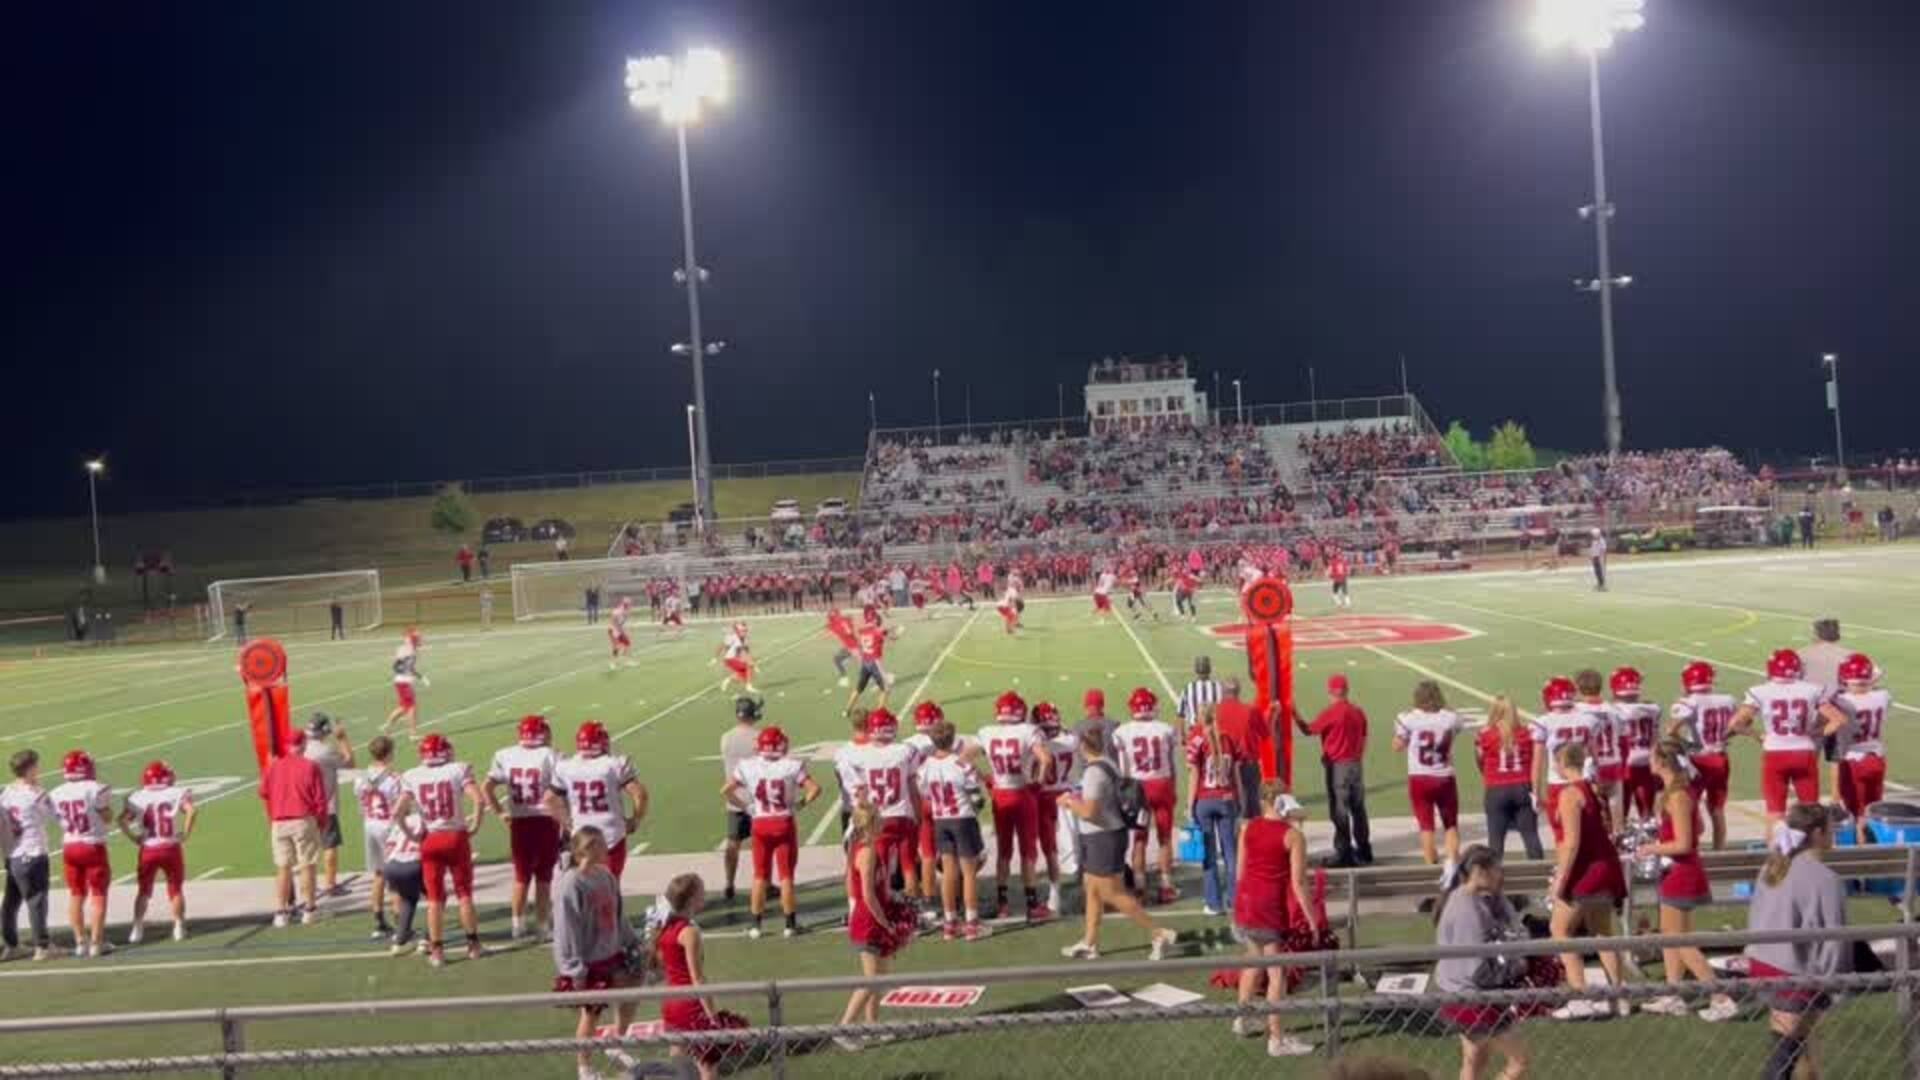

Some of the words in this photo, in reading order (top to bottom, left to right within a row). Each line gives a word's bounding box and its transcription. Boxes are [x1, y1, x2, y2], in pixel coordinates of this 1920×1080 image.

[1771, 699, 1808, 736] 23
[990, 738, 1022, 776] 62
[1133, 736, 1161, 772] 21
[1418, 730, 1452, 767] 24
[510, 767, 542, 805] 53
[573, 779, 608, 815] 72
[755, 779, 786, 813] 43
[868, 772, 901, 808] 59
[58, 799, 90, 834] 36
[142, 802, 173, 839] 46
